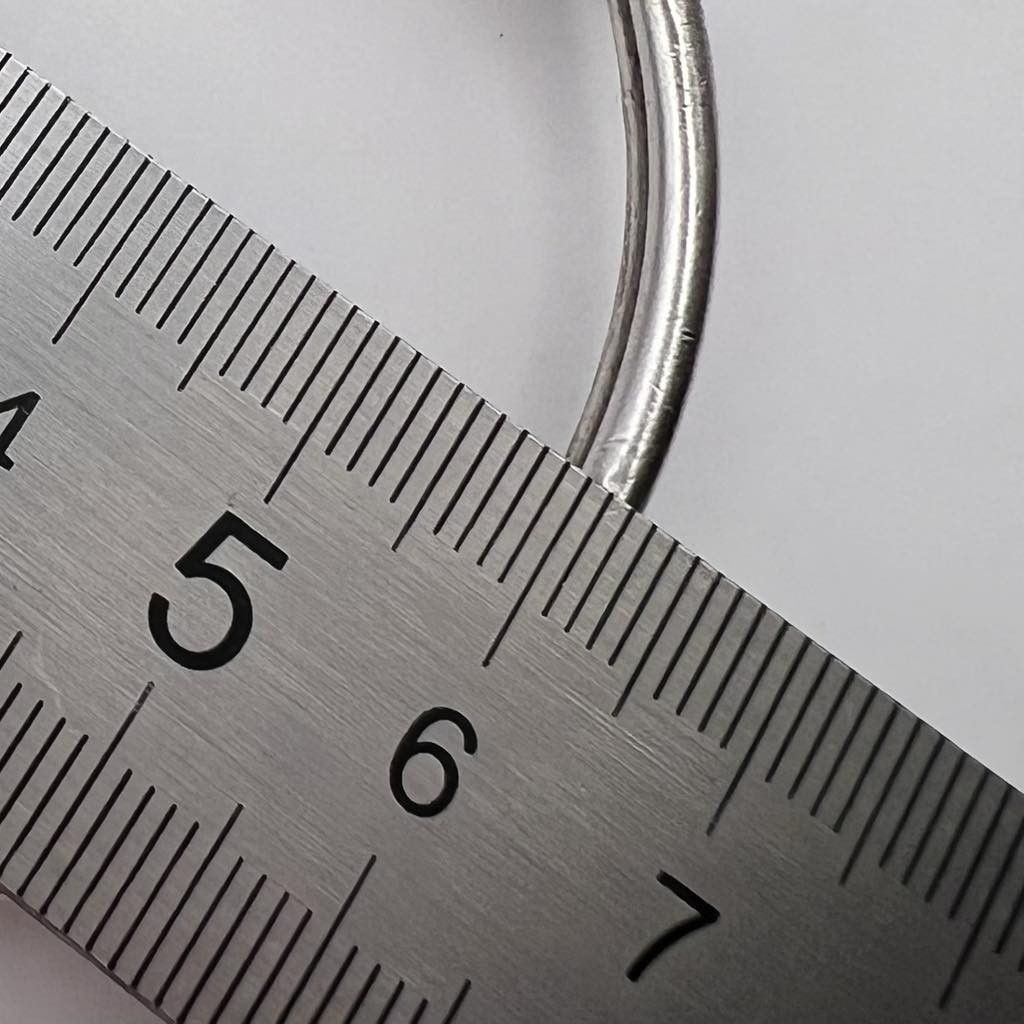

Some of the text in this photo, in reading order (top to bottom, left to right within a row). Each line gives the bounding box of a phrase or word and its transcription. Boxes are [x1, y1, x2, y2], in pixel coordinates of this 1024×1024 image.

[146, 510, 289, 672] 5
[388, 706, 479, 819] 6
[624, 868, 722, 984] 7
